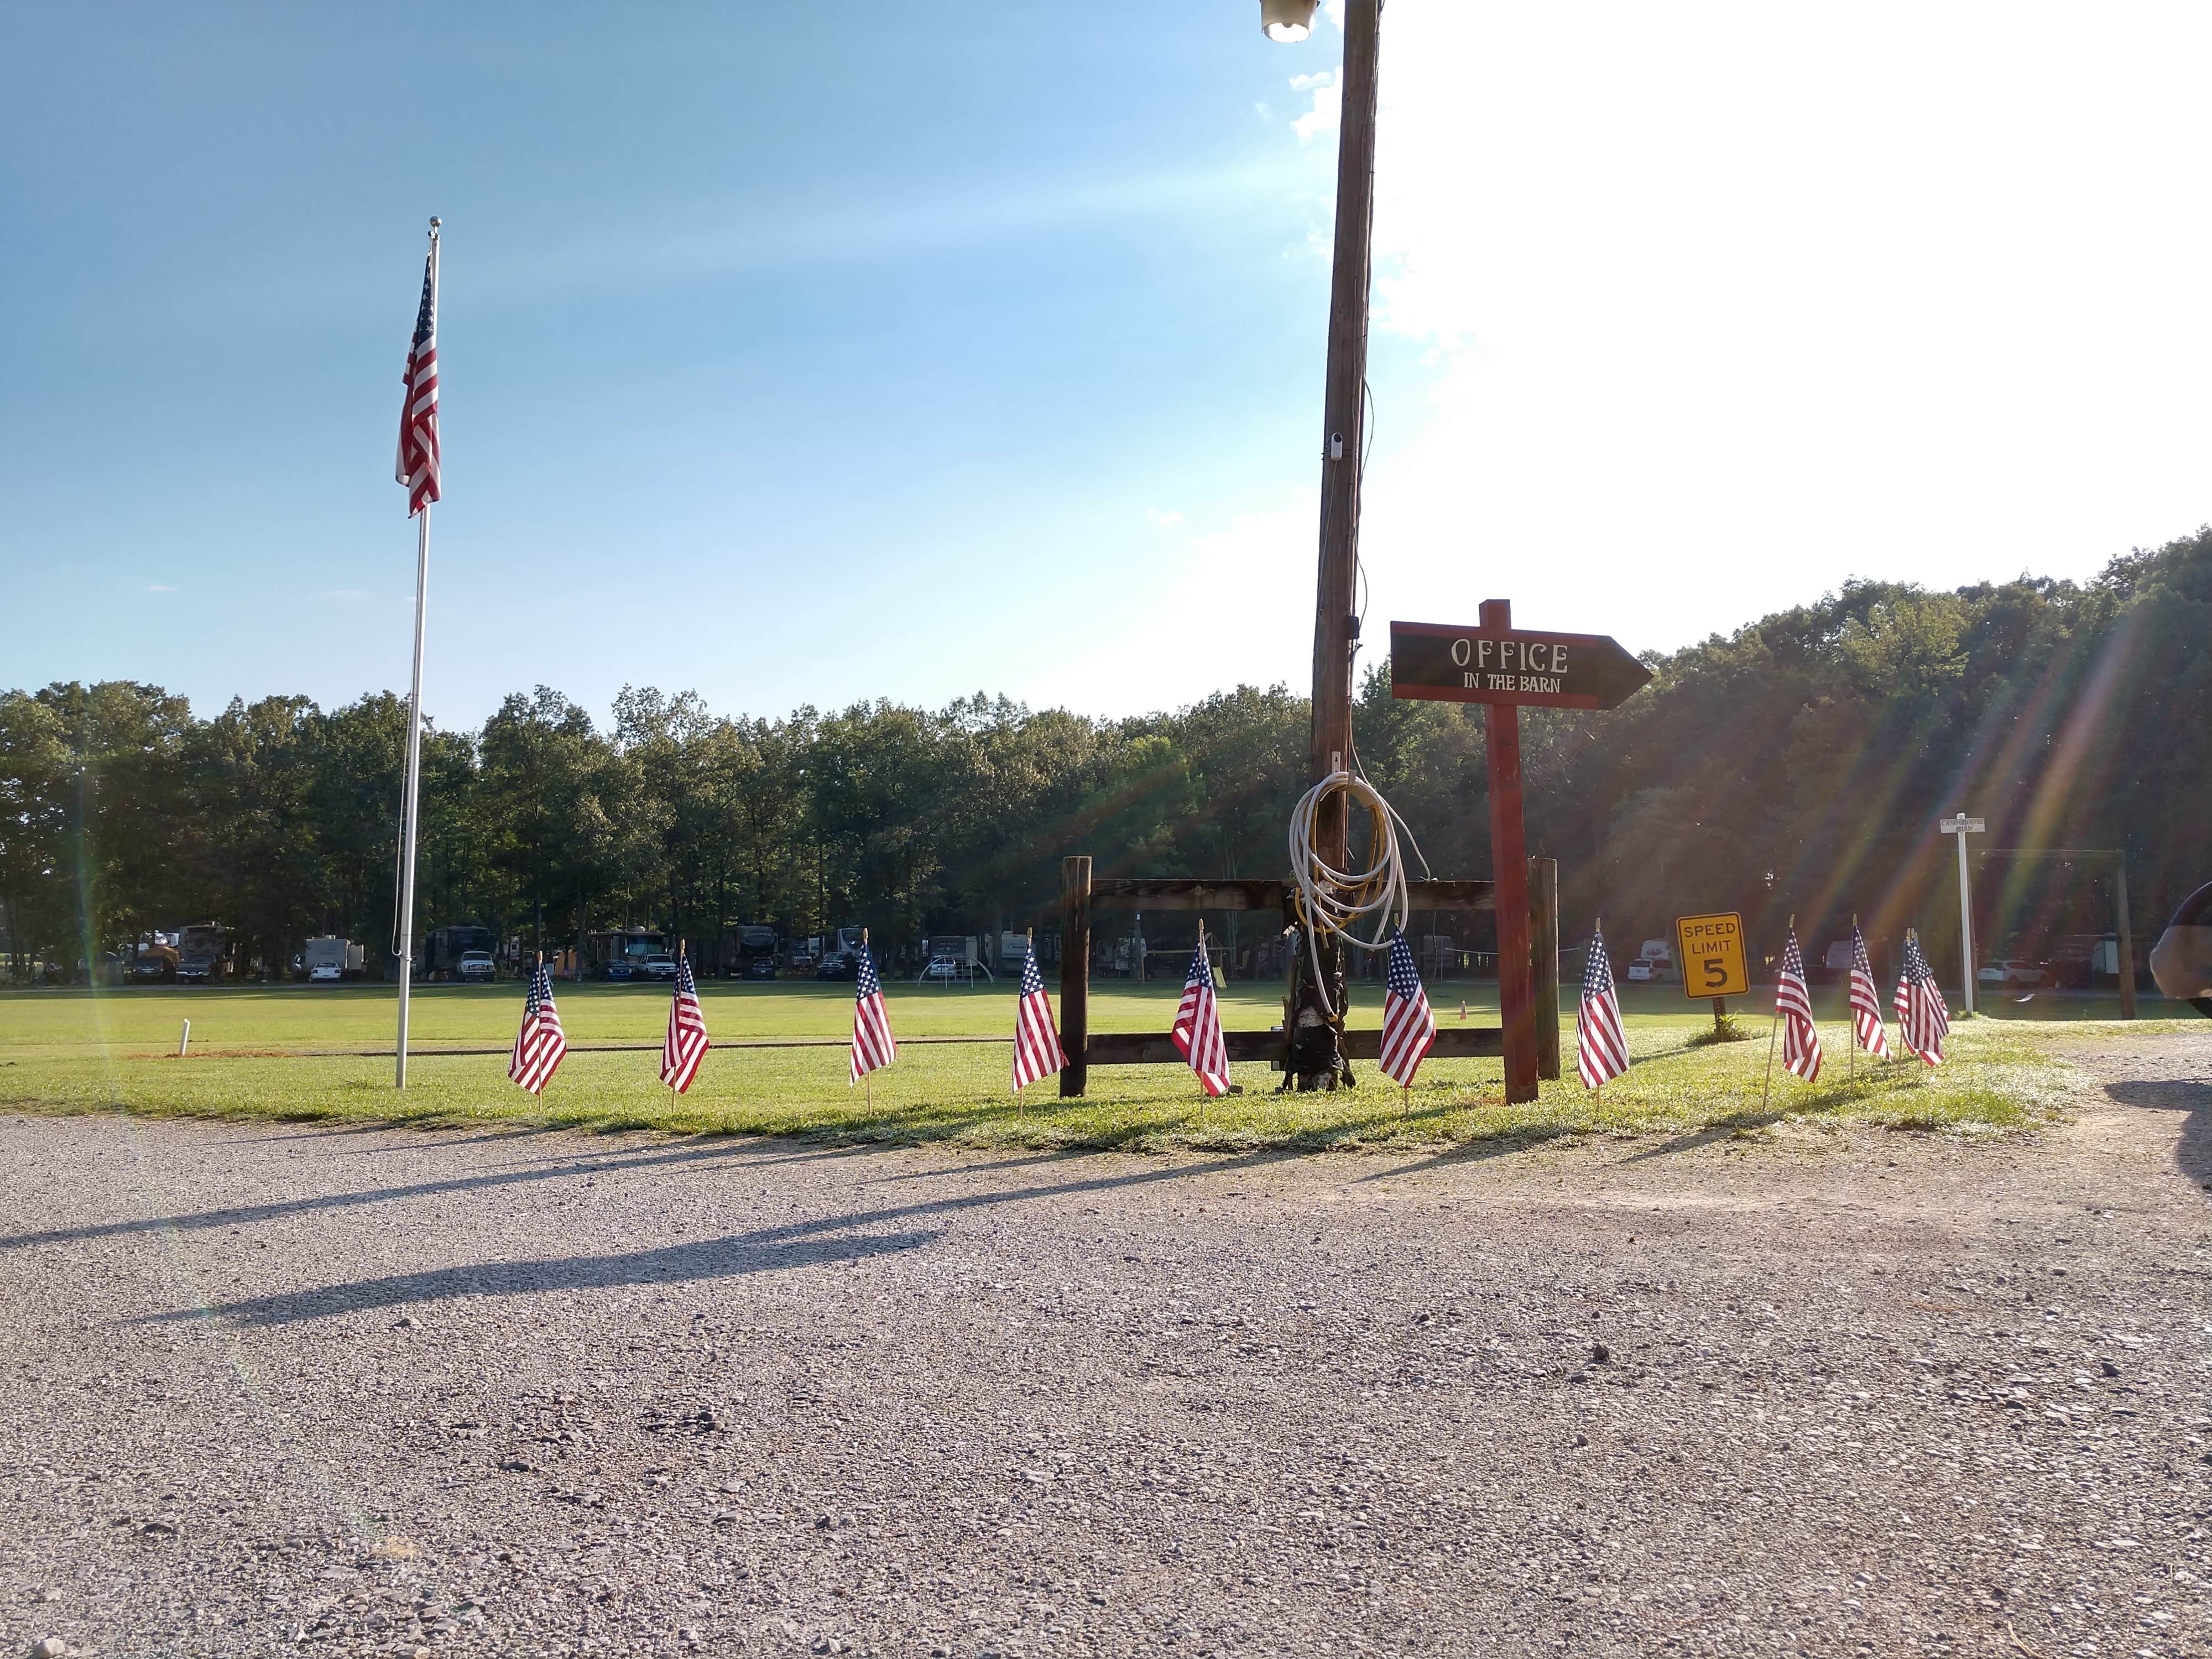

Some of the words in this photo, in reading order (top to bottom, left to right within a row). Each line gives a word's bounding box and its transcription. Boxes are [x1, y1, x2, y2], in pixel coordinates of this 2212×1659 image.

[1451, 638, 1567, 674] OFFICE
[1464, 672, 1479, 688] IN
[1488, 674, 1515, 691] THE
[1520, 676, 1561, 693] BARN
[1684, 922, 1736, 937] SPEED
[1692, 940, 1731, 954] LIMIT
[1703, 958, 1728, 988] 5
